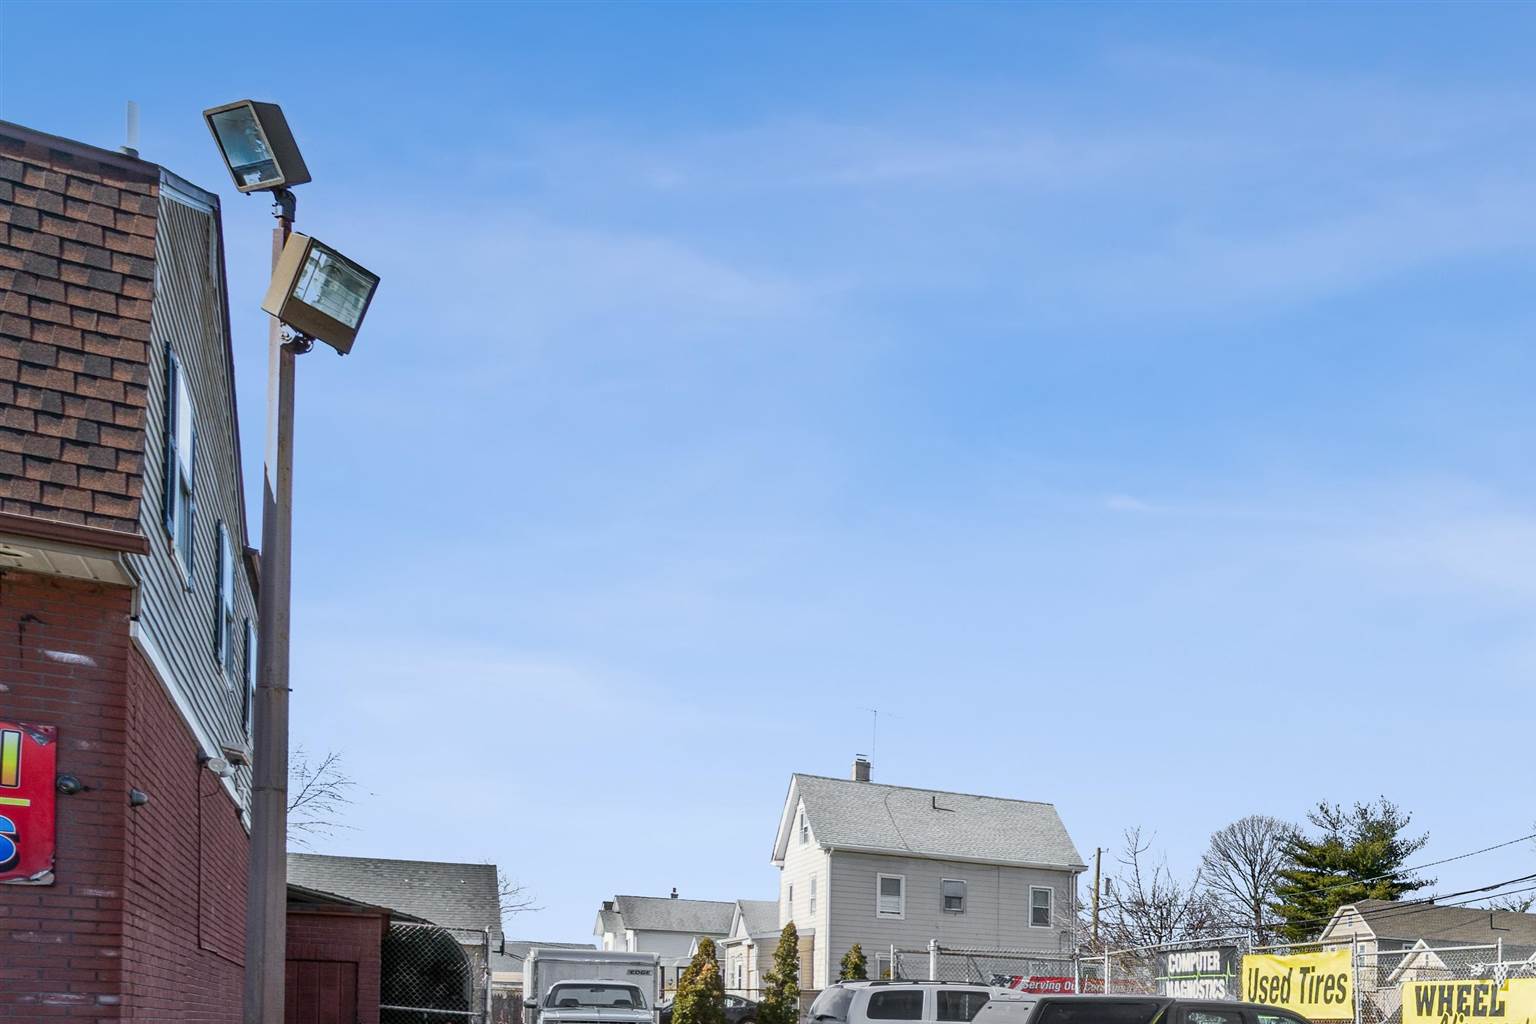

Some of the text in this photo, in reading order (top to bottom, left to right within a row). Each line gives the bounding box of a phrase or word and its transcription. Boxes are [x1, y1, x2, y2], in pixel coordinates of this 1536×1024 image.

[1168, 951, 1220, 973] COMPUTER
[1023, 980, 1061, 992] Serving
[1248, 966, 1348, 1006] Used Tires
[1415, 984, 1506, 1017] WHEEL
